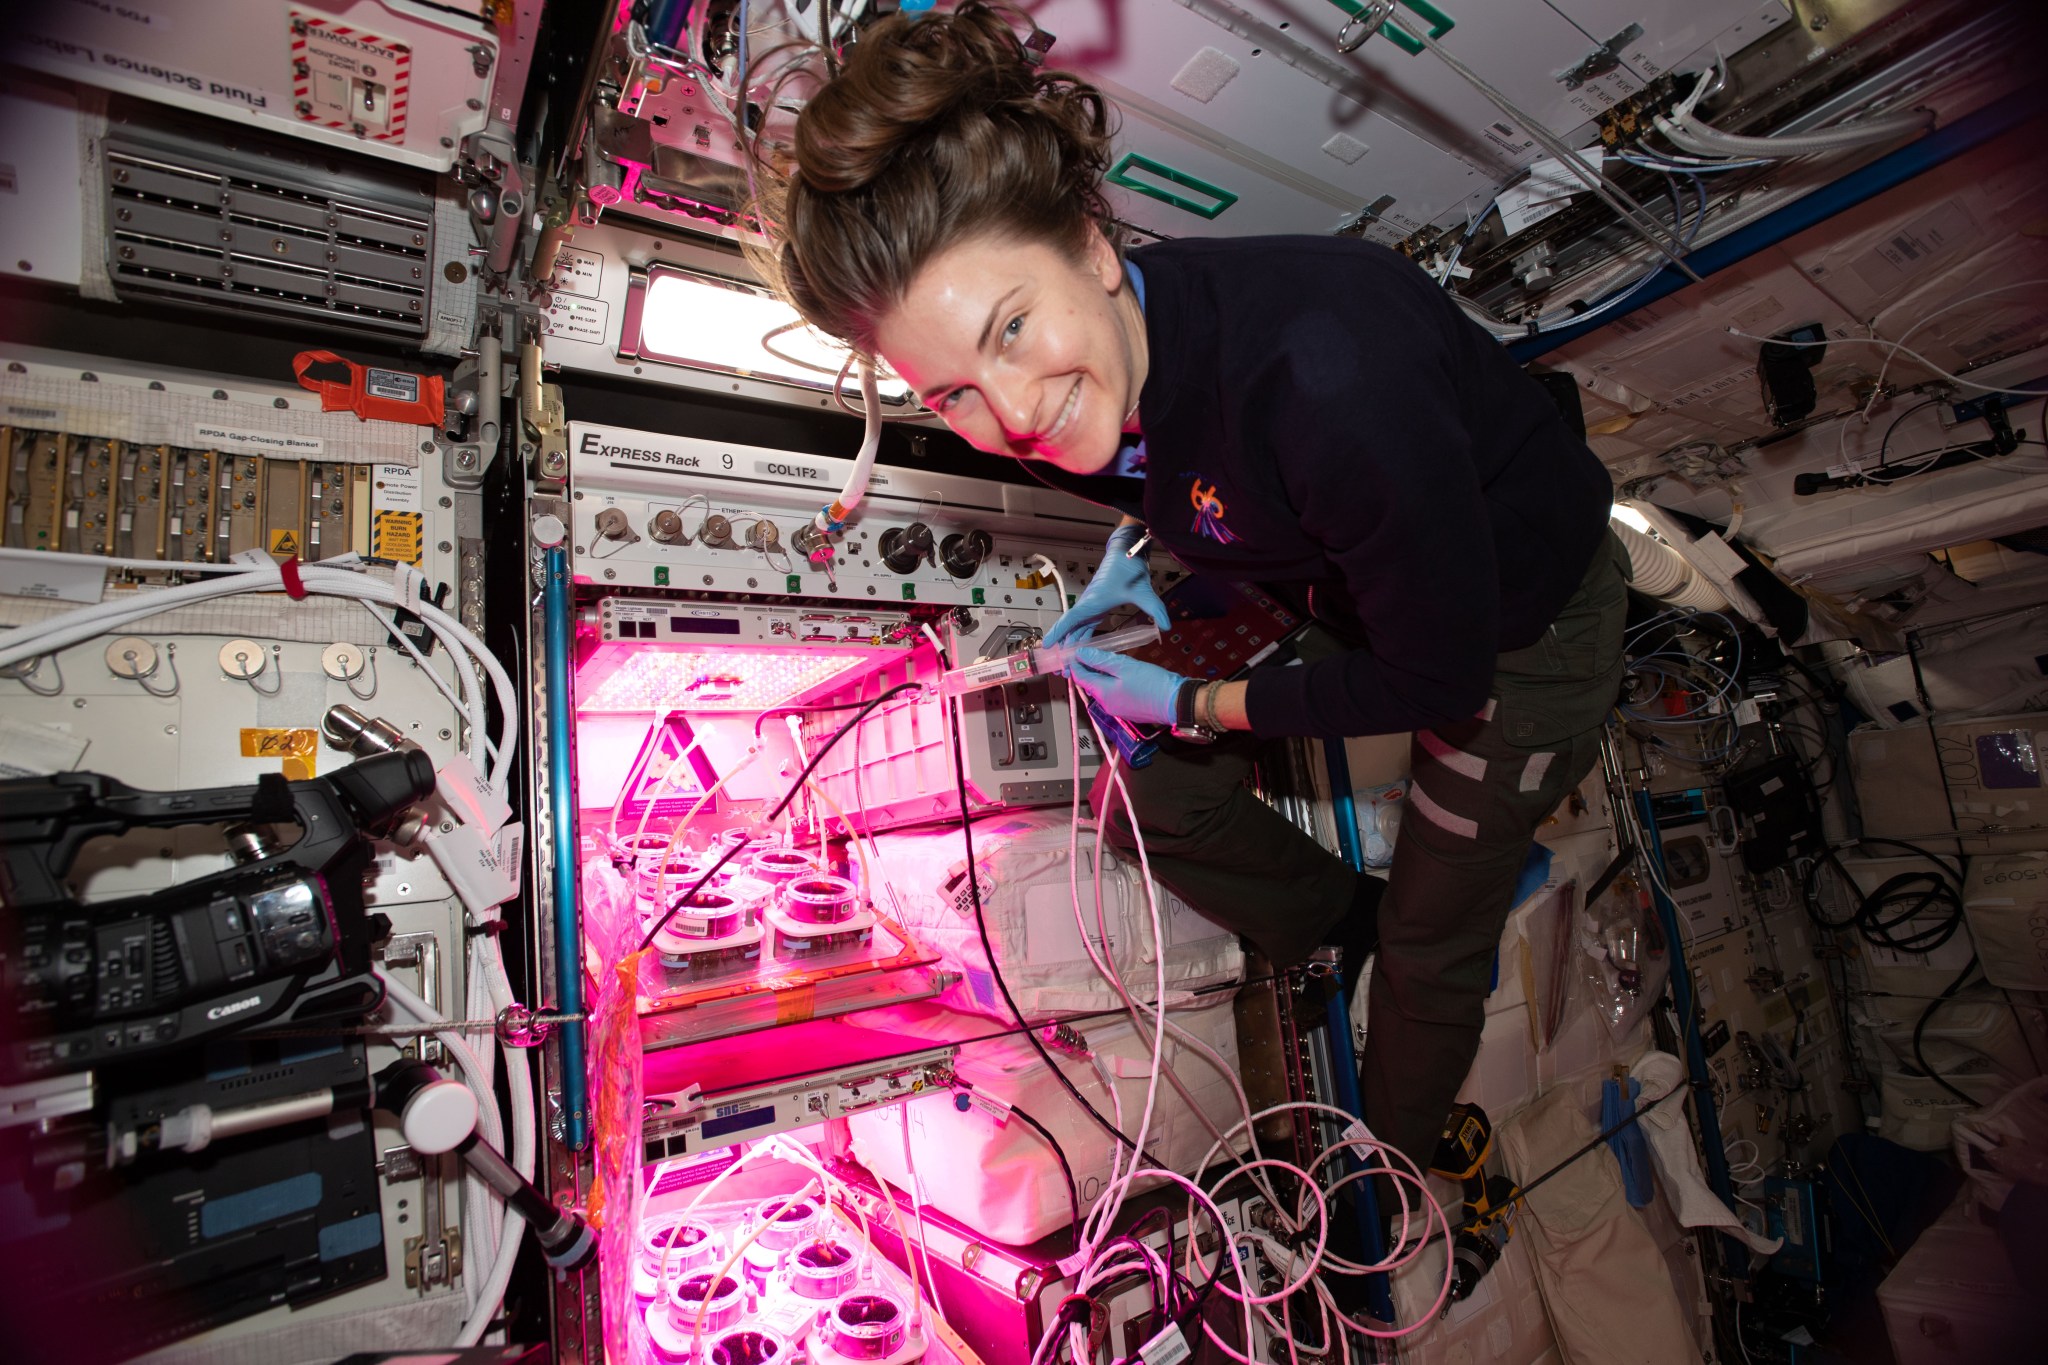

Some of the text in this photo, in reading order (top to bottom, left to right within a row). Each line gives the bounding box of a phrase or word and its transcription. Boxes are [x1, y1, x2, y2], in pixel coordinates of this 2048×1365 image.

[308, 27, 394, 59] RACK POWER
[103, 53, 202, 91] Science
[1644, 60, 1660, 76] DATA
[1618, 79, 1634, 93] DATA
[210, 83, 267, 108] Fluid
[1599, 91, 1615, 105] DATA
[1581, 100, 1598, 116] DATA
[1403, 217, 1421, 229] DATA
[1387, 230, 1404, 240] DATA
[552, 303, 571, 311] MODE
[576, 304, 597, 313] GENERAL
[199, 428, 318, 448] RPDA Gap-Closing Blanket
[665, 453, 700, 468] Rack
[722, 453, 734, 469] 9
[384, 467, 412, 476] RPDA
[767, 463, 817, 479] COL1F2
[385, 518, 412, 526] WARNING
[207, 995, 261, 1020] Canon
